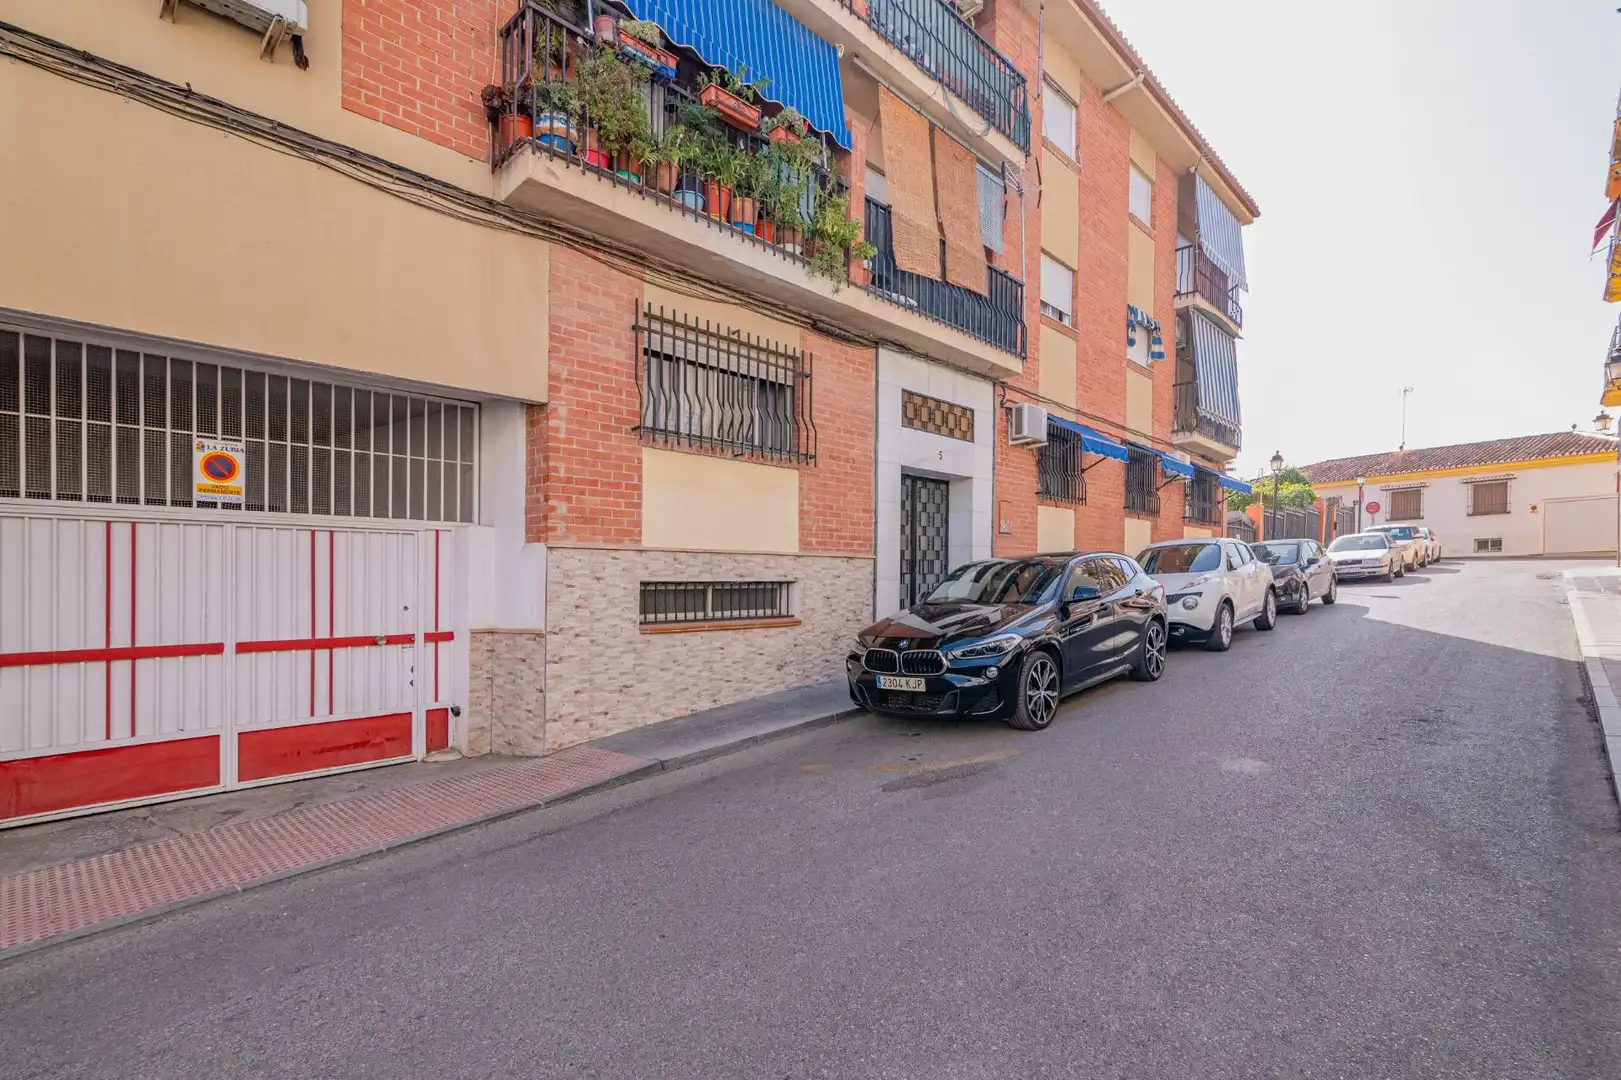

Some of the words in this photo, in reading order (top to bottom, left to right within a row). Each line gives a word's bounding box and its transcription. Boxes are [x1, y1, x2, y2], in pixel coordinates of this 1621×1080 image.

[938, 450, 943, 460] 5
[198, 488, 241, 496] PERMANENTE
[882, 678, 903, 689] 2304
[905, 679, 923, 690] KJP
